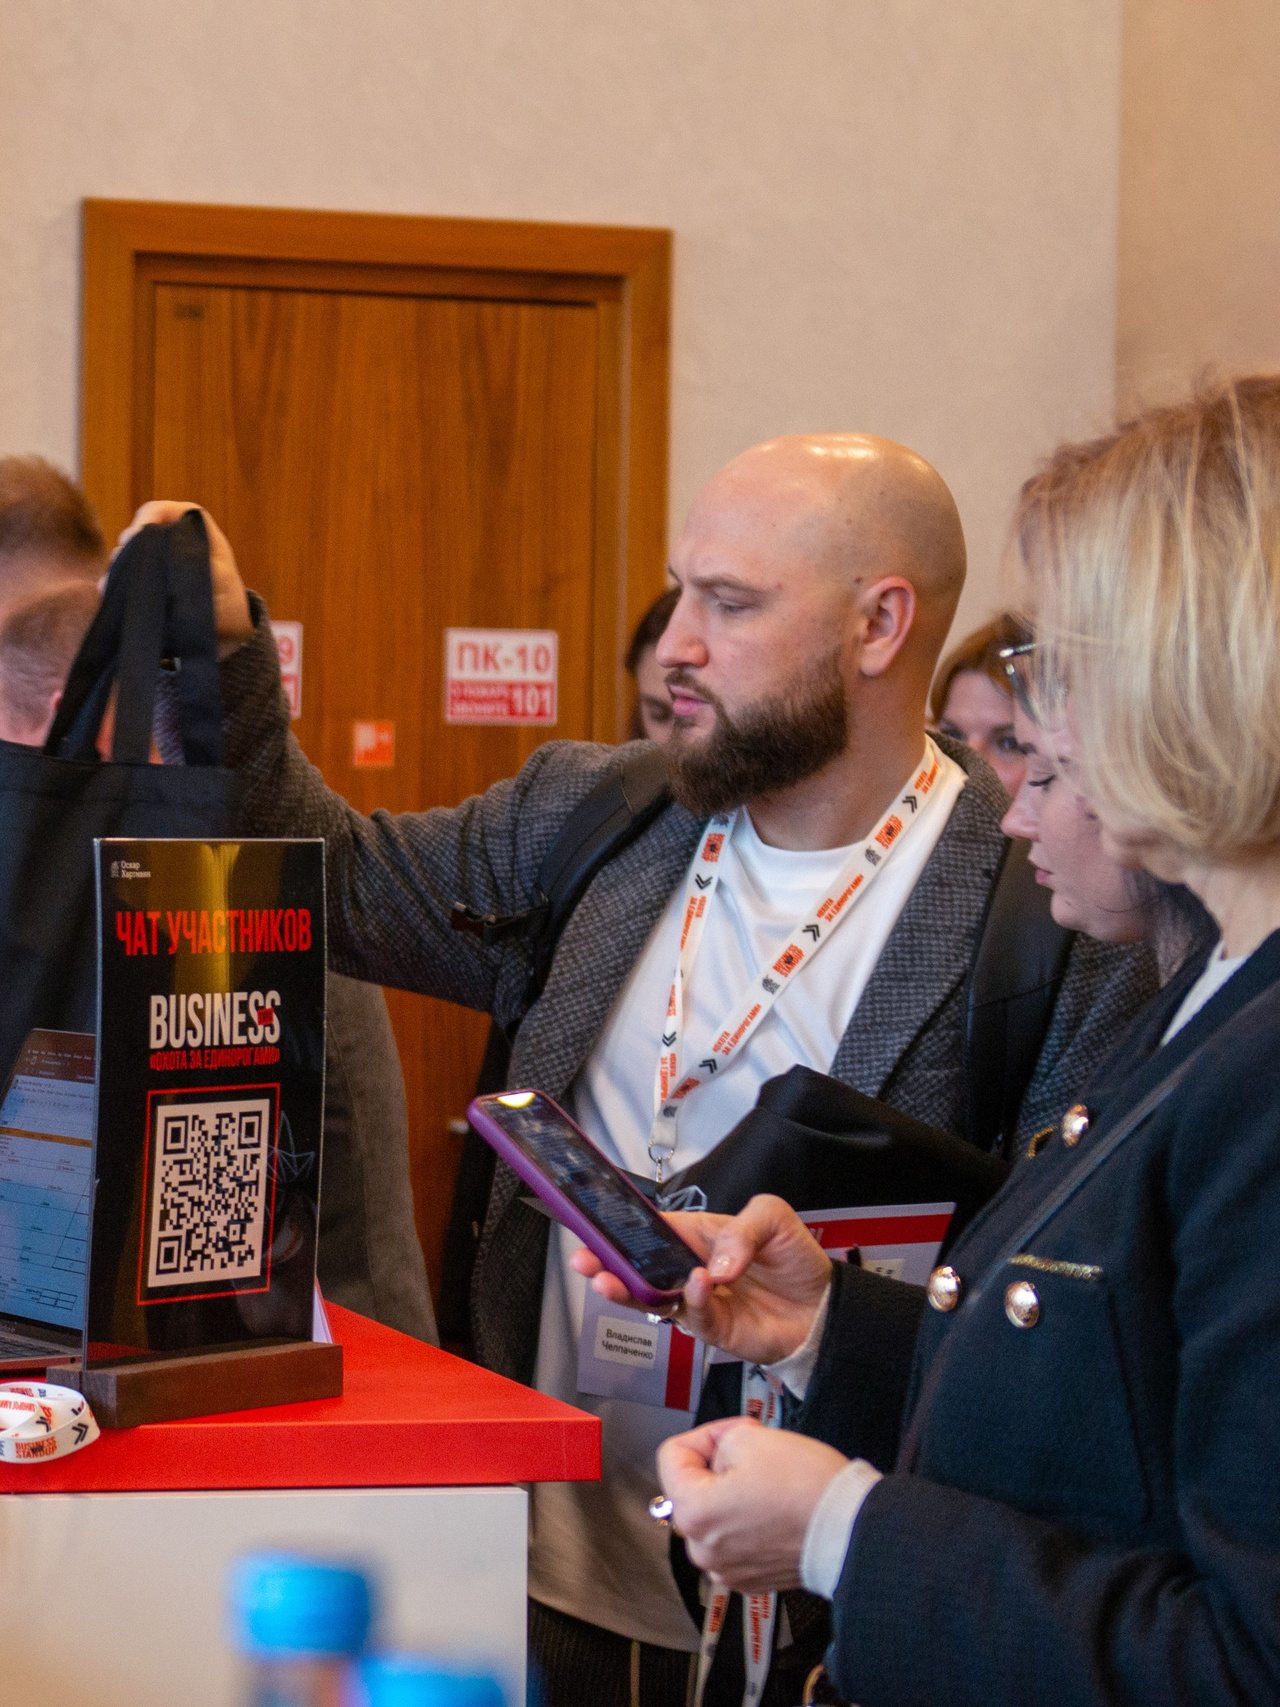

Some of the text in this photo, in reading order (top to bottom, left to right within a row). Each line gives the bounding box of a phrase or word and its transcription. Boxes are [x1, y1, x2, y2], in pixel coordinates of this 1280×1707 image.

[457, 641, 551, 675] ПК-10
[512, 685, 551, 715] 101
[116, 908, 312, 956] ЧАТ УЧАСТНИКОВ
[149, 989, 282, 1049] BUSINESS
[189, 1050, 202, 1069] ЗА
[606, 1328, 653, 1347] Владислав
[602, 1340, 654, 1360] Челпаченко
[14, 1436, 57, 1451] BUSINESS
[15, 1446, 57, 1459] STANDUP
